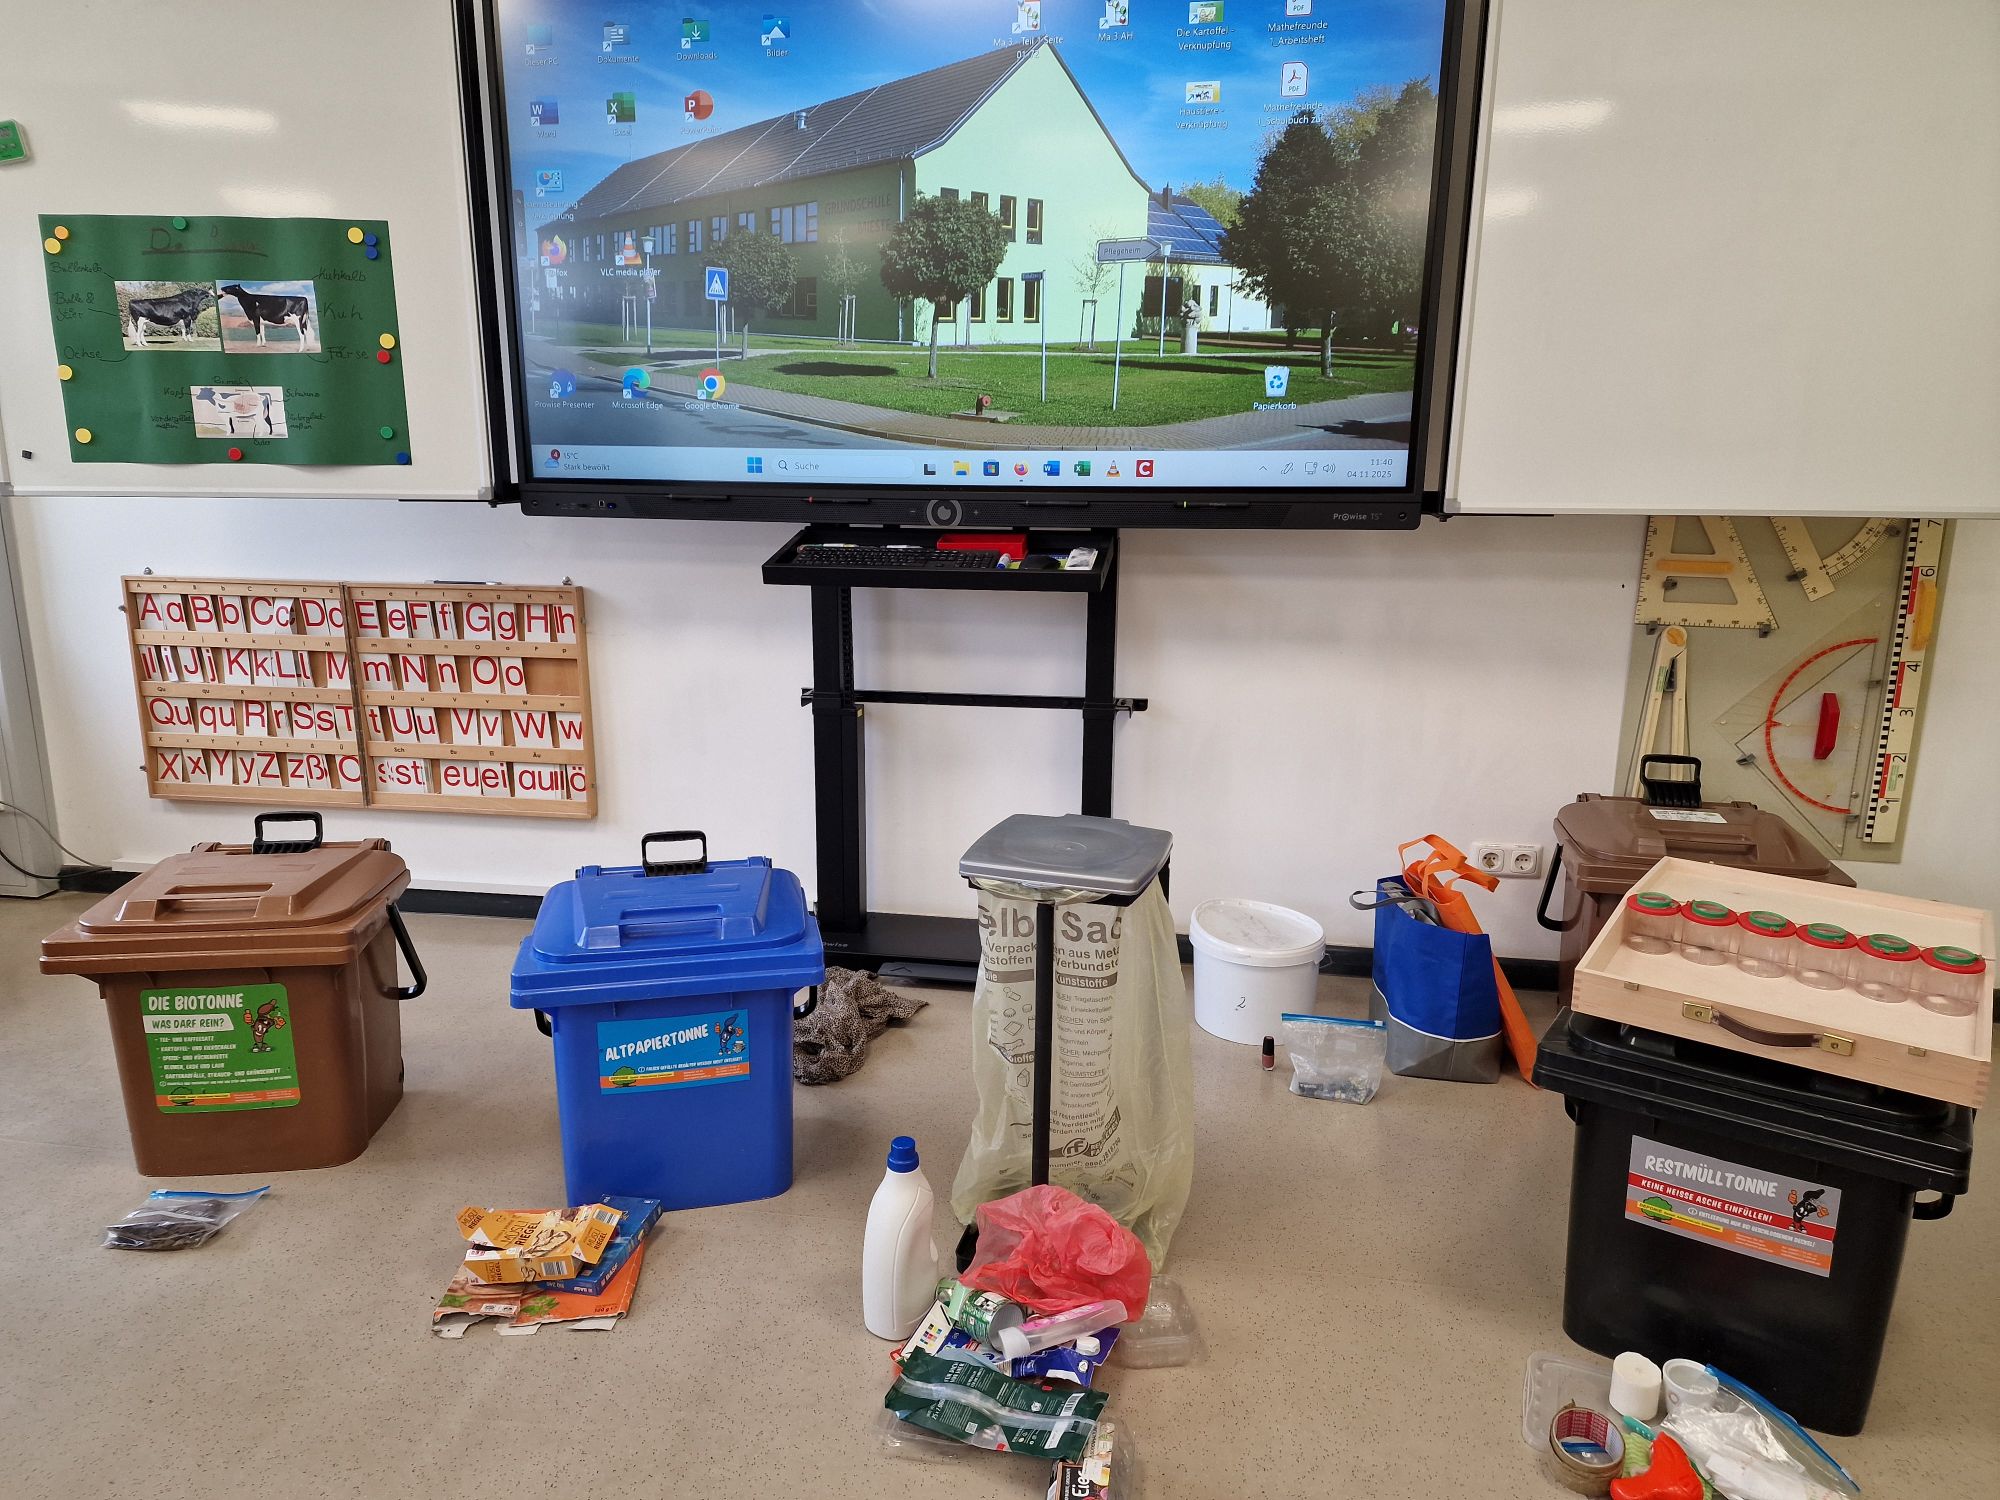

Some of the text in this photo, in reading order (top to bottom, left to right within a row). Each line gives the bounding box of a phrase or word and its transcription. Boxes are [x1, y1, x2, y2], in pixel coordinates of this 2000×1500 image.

[1176, 26, 1229, 37] Die Kartoffel
[1267, 21, 1328, 32] Mathefreunde
[676, 52, 718, 62] Downloads
[766, 47, 789, 57] Bilder
[597, 55, 640, 65] Dokumente
[1263, 102, 1323, 113] Mathefreunde
[1103, 247, 1141, 256] Pflegeheim
[600, 268, 661, 278] VLC media player
[323, 301, 363, 320] Kuh
[63, 345, 103, 360] Ochse
[328, 345, 369, 360] Färse
[562, 401, 595, 409] Presenter
[646, 402, 664, 411] Edge
[684, 402, 740, 412] Google Chrome
[1252, 401, 1298, 412] Papierkorb
[563, 463, 582, 471] Stark
[794, 461, 820, 471] Suche
[1370, 458, 1393, 466] 11:40
[1346, 470, 1392, 479] 04.11.2025
[1920, 567, 1935, 577] 6
[140, 593, 550, 640] A B b C D E e F G g H
[184, 648, 524, 687] J K L m N n O o
[1907, 662, 1922, 673] 4
[149, 697, 547, 739] Qu qu R S s t U u V v W
[1899, 708, 1915, 718] 3
[1892, 753, 1907, 763] 2
[158, 749, 305, 784] X x Y y Z z
[1068, 949, 1091, 959] aus
[148, 993, 244, 1011] DIE BIOTONNE
[152, 1017, 225, 1030] WAS DARF REIN?
[604, 1023, 709, 1062] ALTPAPIERTONNE
[1644, 1154, 1779, 1198] RESTMÜLLTONNE
[1641, 1179, 1665, 1193] KEINE
[1665, 1186, 1694, 1201] HEISSE
[1695, 1194, 1723, 1210] ASCHE
[1724, 1202, 1773, 1223] EINFÜLLEN!
[467, 1214, 485, 1230] RIEGEL
[514, 1220, 542, 1246] RIEGEL
[594, 1232, 608, 1251] RIEGEL
